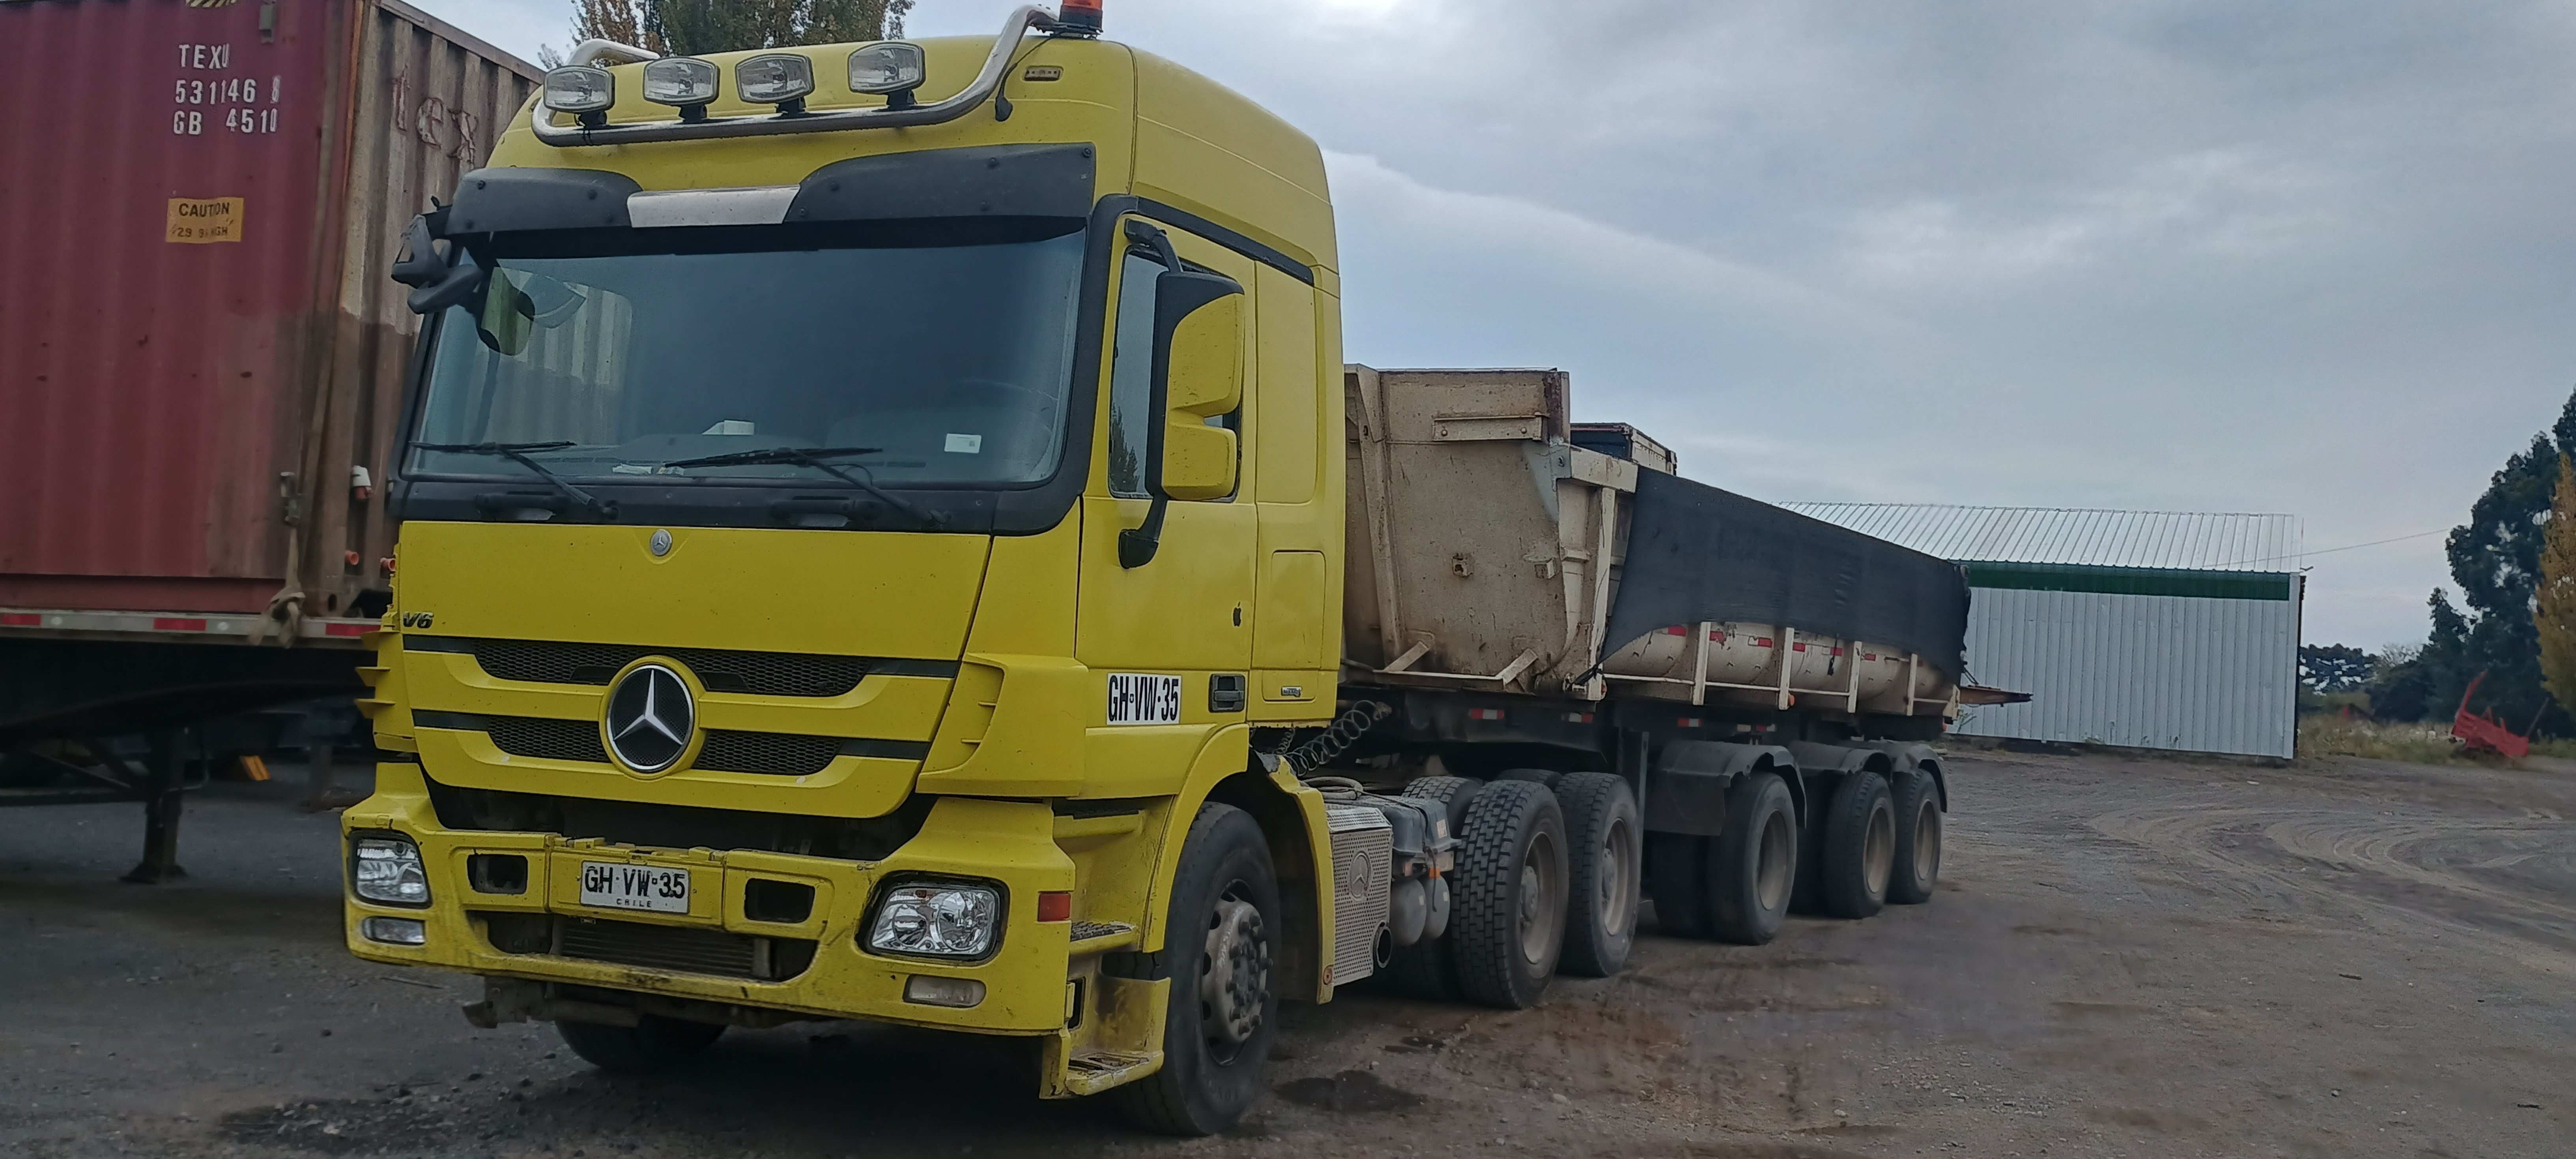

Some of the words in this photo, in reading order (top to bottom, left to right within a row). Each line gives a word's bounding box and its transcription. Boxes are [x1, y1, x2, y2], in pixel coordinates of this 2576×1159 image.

[175, 79, 256, 105] 531146
[226, 108, 278, 133] 4510
[403, 611, 434, 628] V6
[617, 898, 652, 907] CHILE
